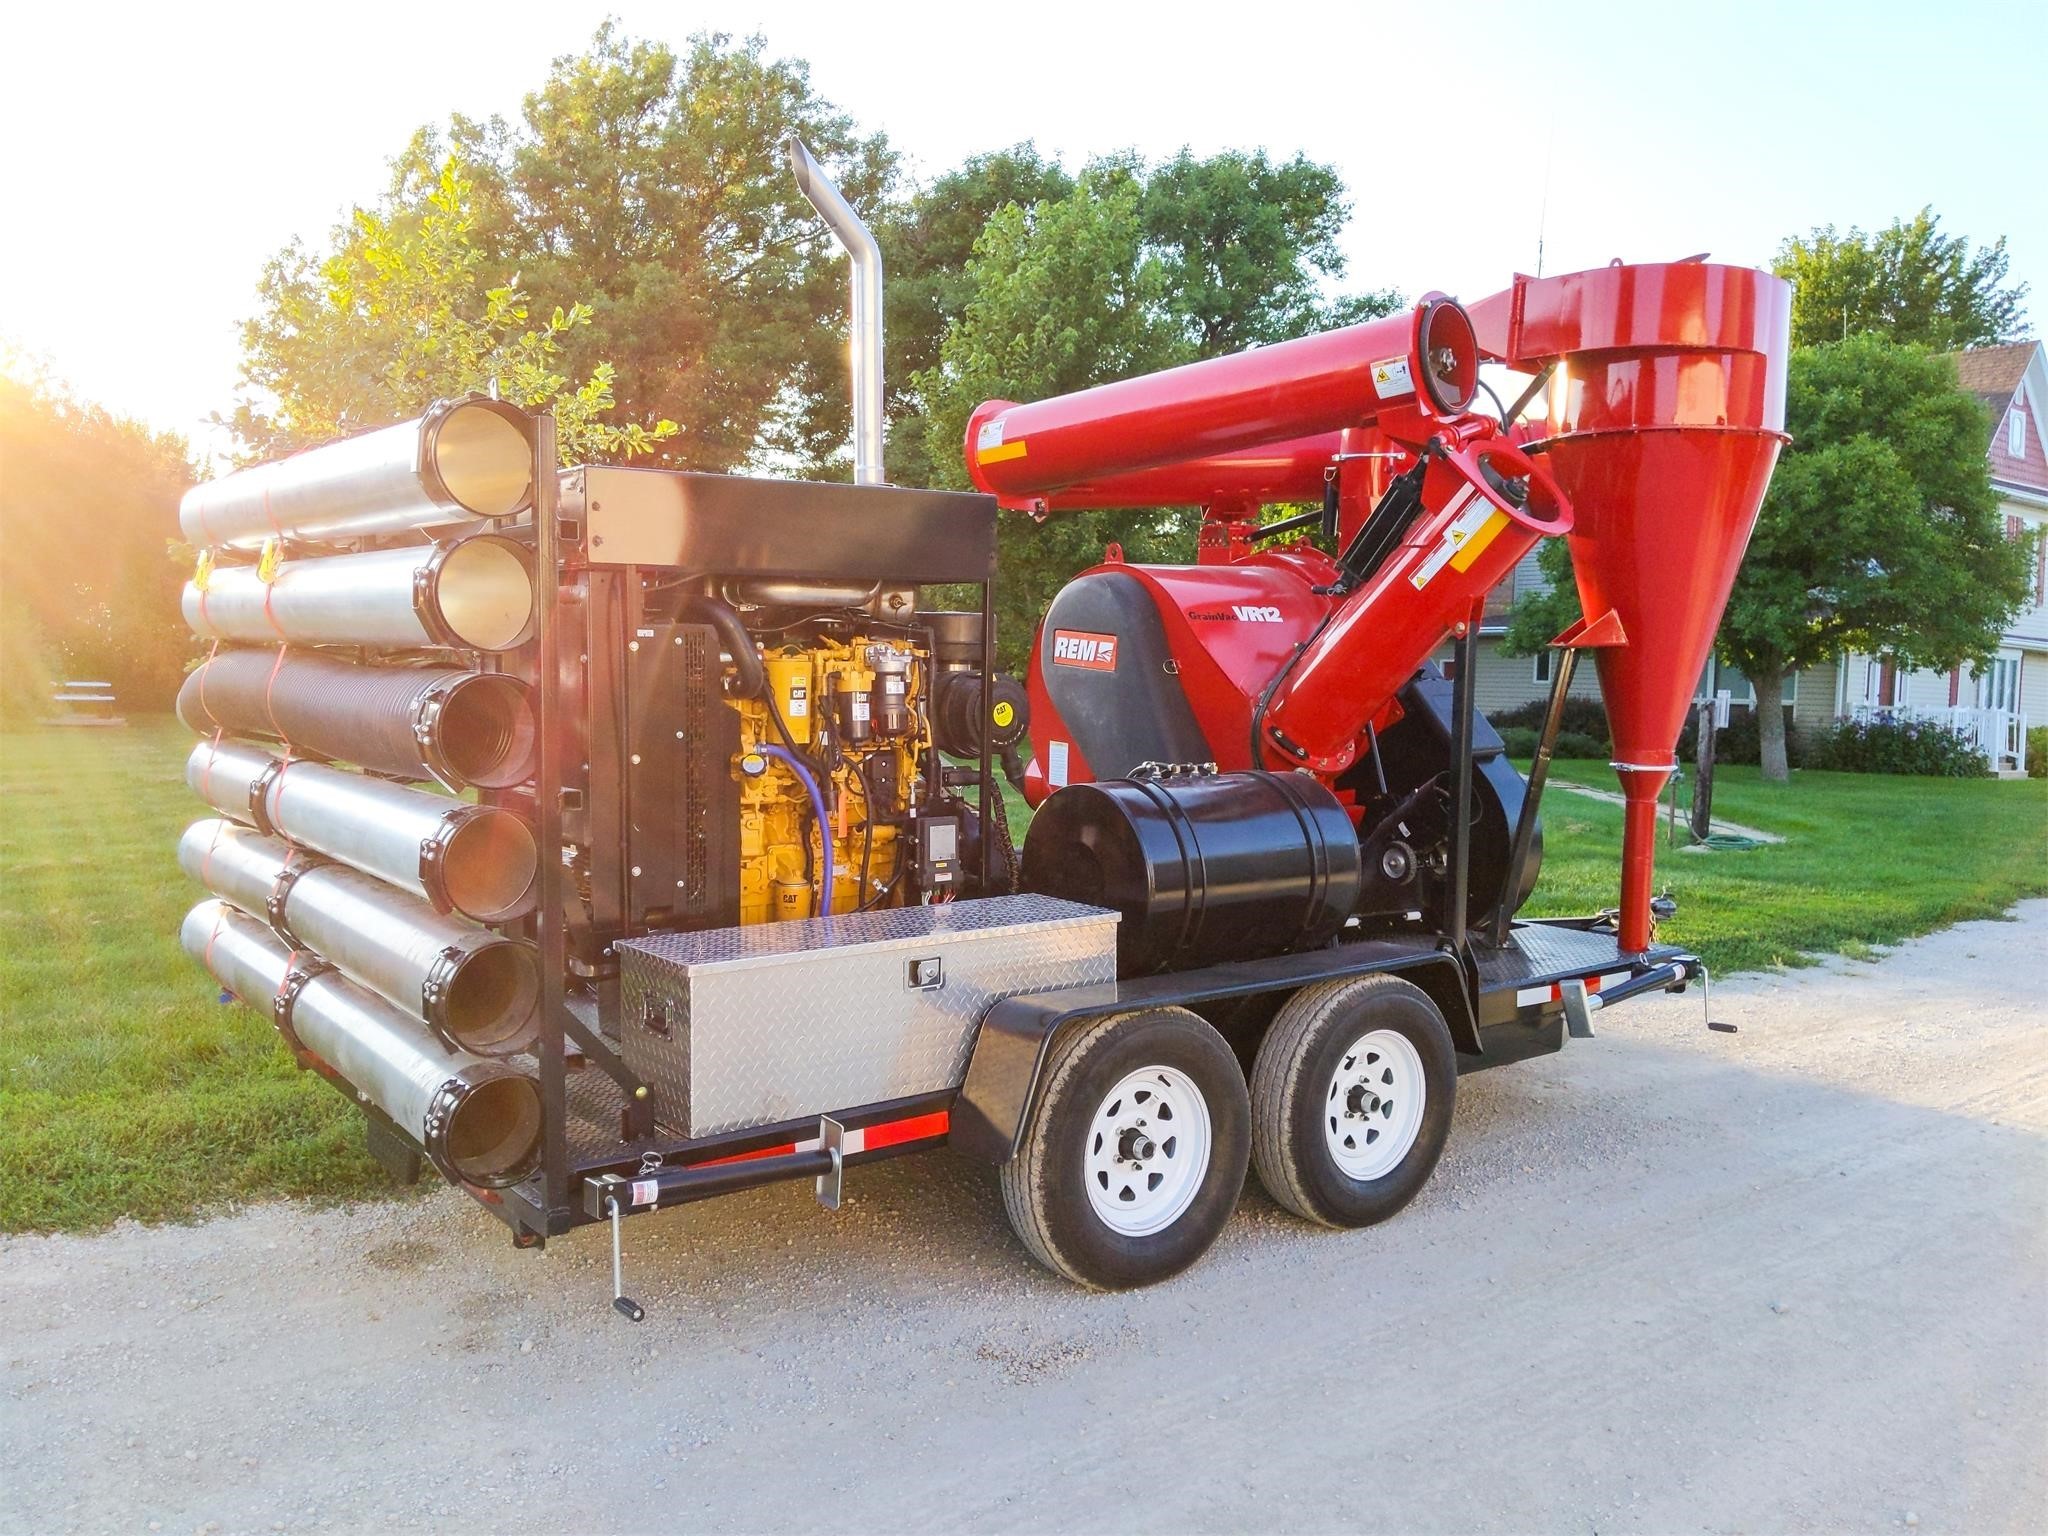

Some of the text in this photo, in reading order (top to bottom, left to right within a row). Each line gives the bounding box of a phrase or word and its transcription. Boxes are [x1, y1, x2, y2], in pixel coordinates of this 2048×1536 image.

[1188, 605, 1283, 622] GrainVac VR12
[1054, 636, 1097, 662] REM
[792, 689, 806, 699] CAT
[996, 704, 1006, 716] CAT
[783, 894, 798, 903] CAT
